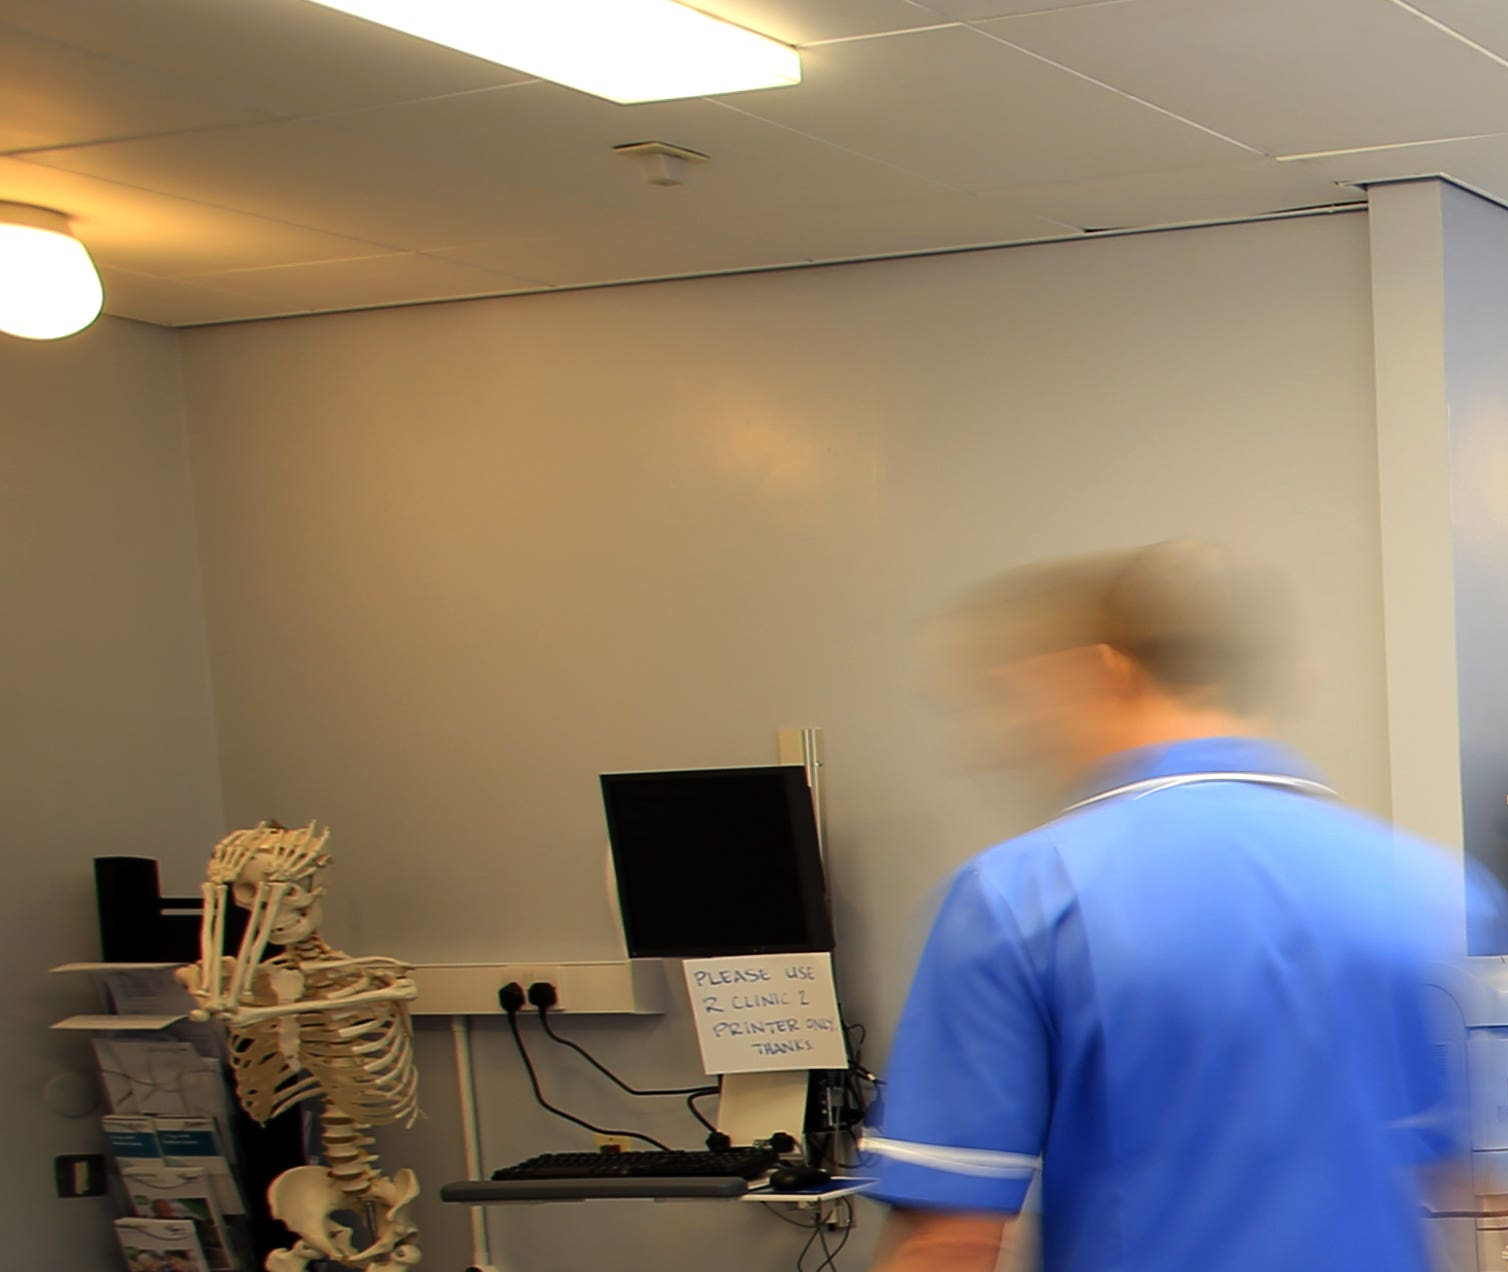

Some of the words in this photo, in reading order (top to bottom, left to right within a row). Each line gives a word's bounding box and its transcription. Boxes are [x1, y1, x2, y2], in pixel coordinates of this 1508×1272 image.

[693, 967, 771, 987] PLEASE
[785, 965, 815, 981] USE
[732, 991, 789, 1011] CLINIC
[713, 1018, 800, 1038] PRINTER
[752, 1039, 813, 1056] THANKS
